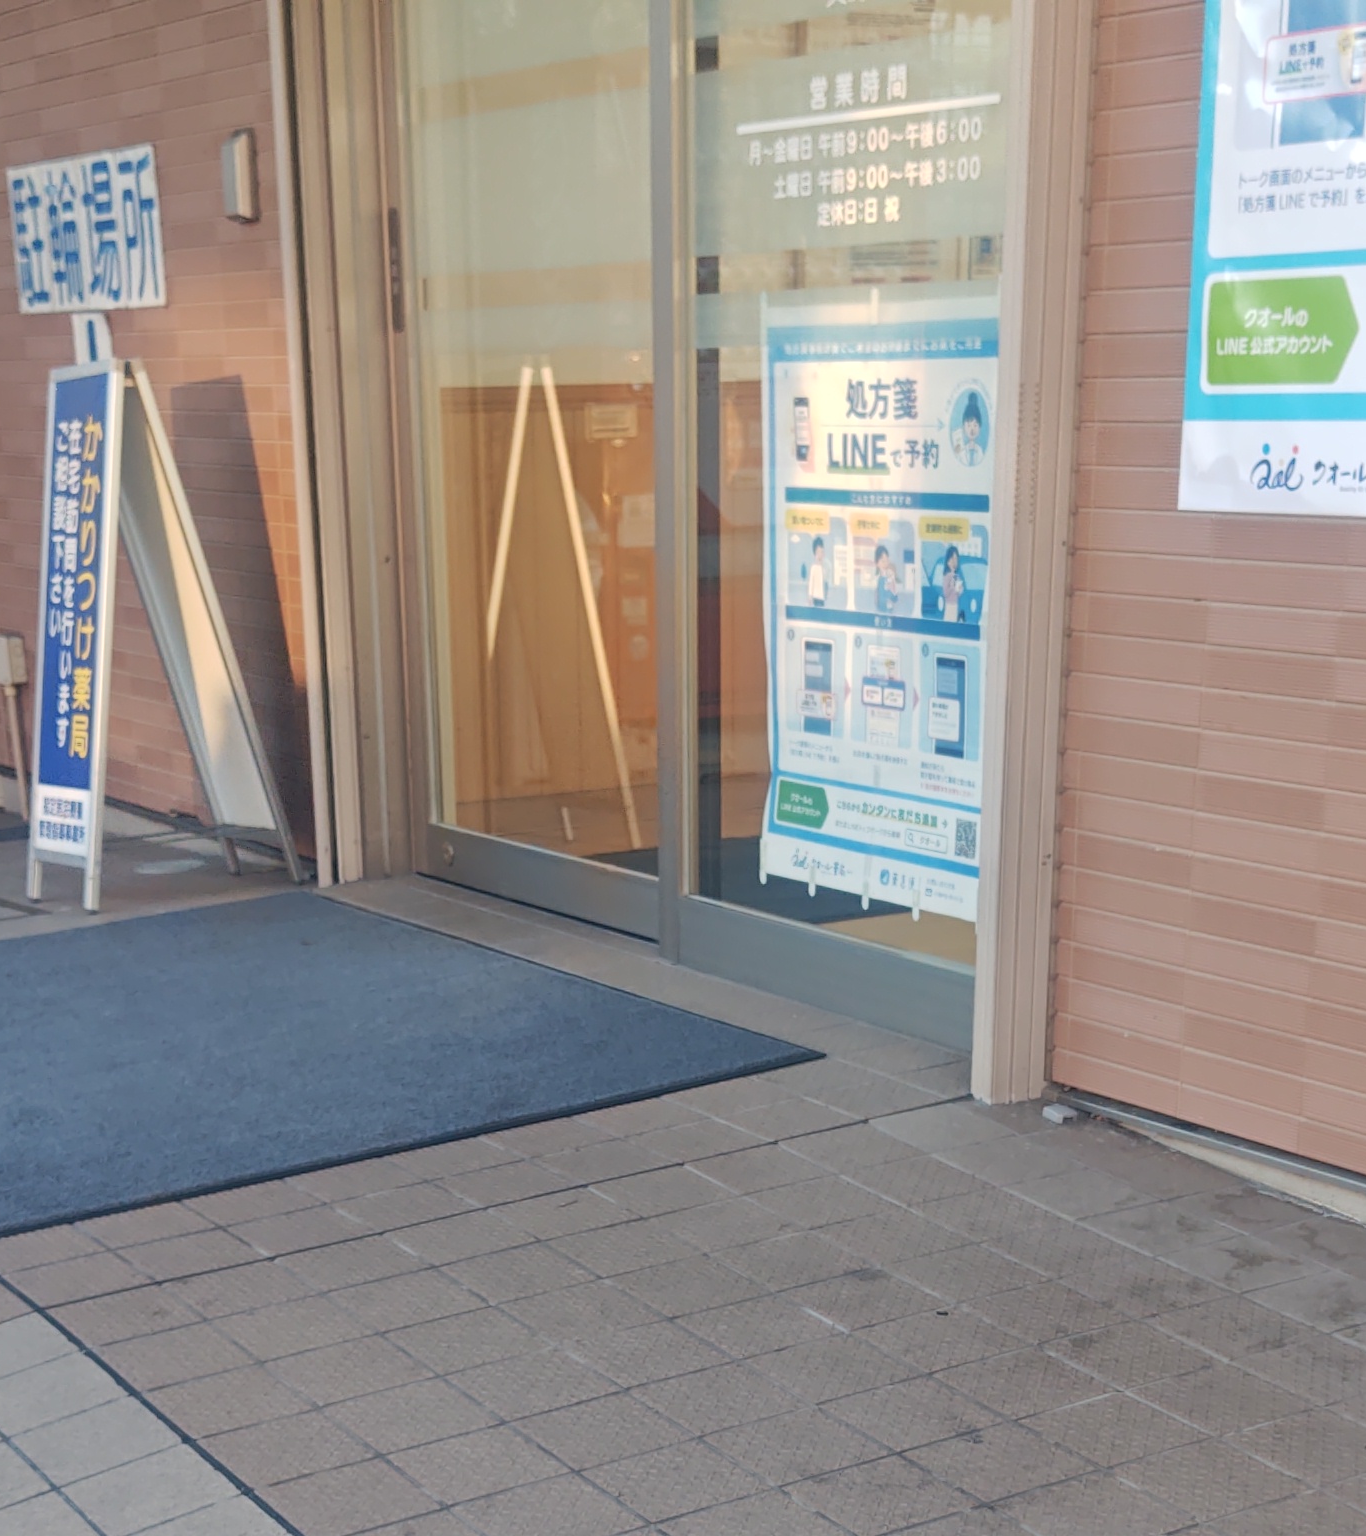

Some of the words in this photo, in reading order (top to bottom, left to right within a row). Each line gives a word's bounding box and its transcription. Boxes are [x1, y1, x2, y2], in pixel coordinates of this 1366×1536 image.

[809, 63, 908, 111] 営業時間
[1243, 306, 1309, 329] クオールの
[846, 378, 918, 420] 処方箋
[827, 433, 940, 470] LINEで予約
[68, 413, 103, 759] かかりつけ薬局
